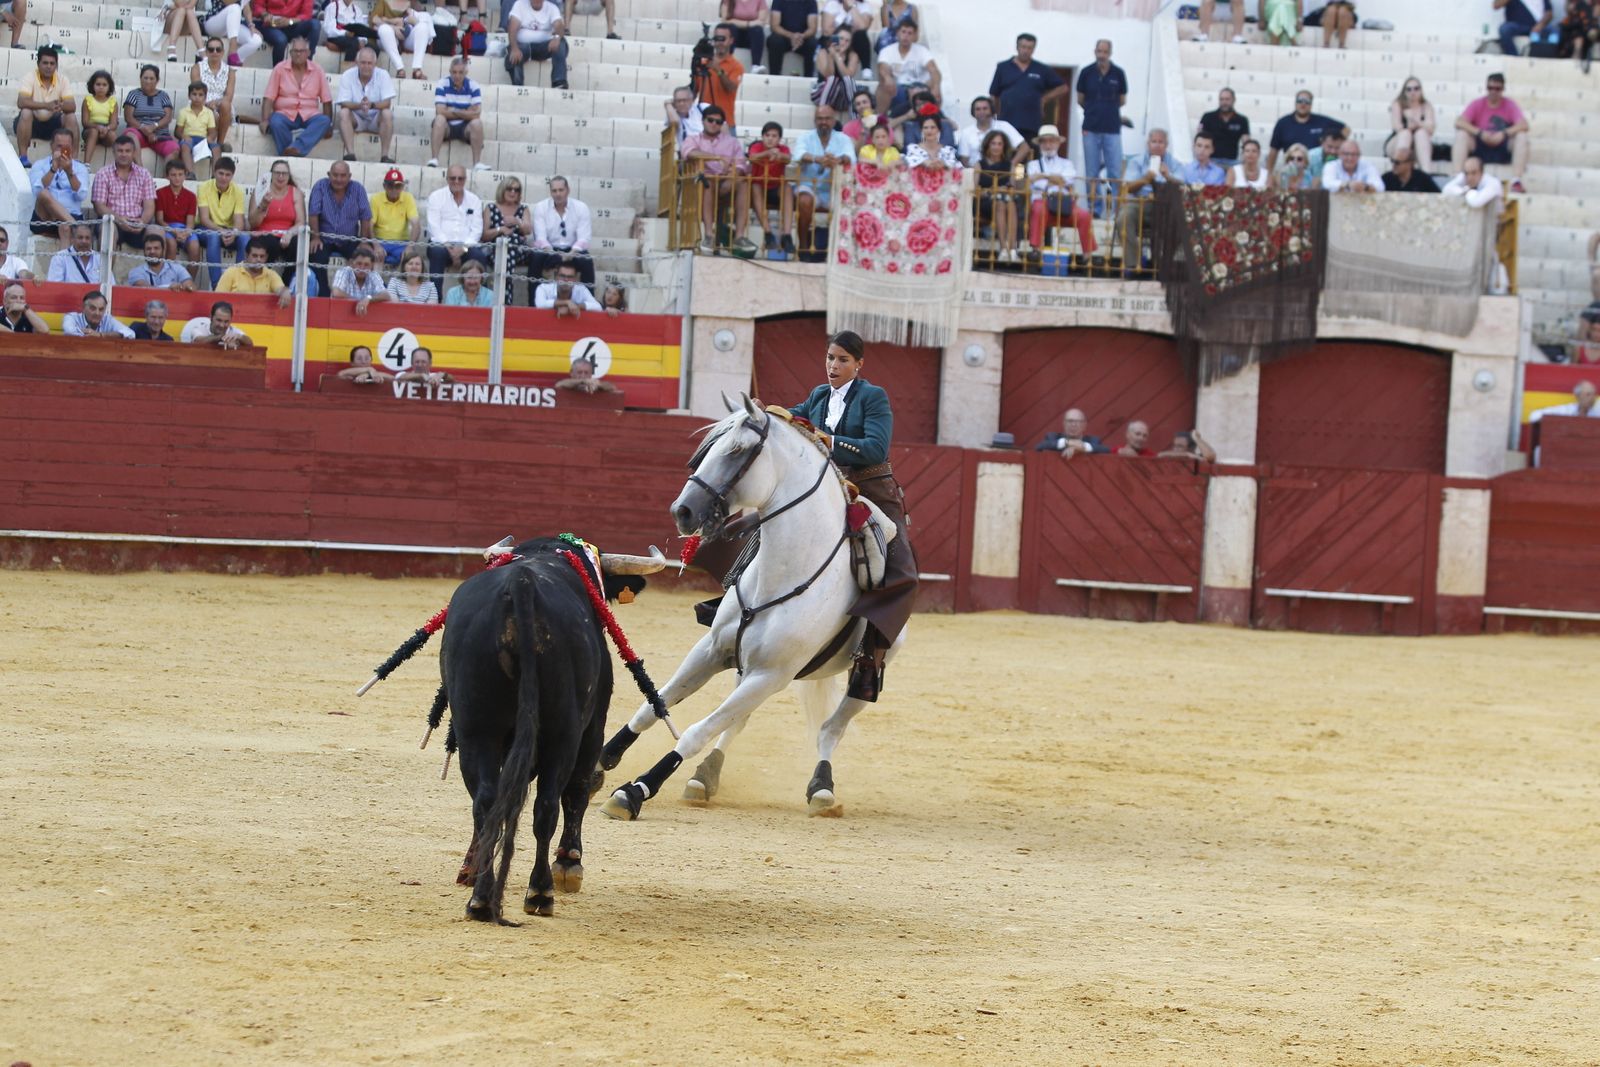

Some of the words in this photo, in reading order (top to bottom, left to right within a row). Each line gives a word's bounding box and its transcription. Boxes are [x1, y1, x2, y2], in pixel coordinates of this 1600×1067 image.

[71, 4, 84, 13] 26
[119, 8, 132, 16] 27
[385, 332, 406, 367] 4
[392, 379, 557, 409] VETERINARIOS
